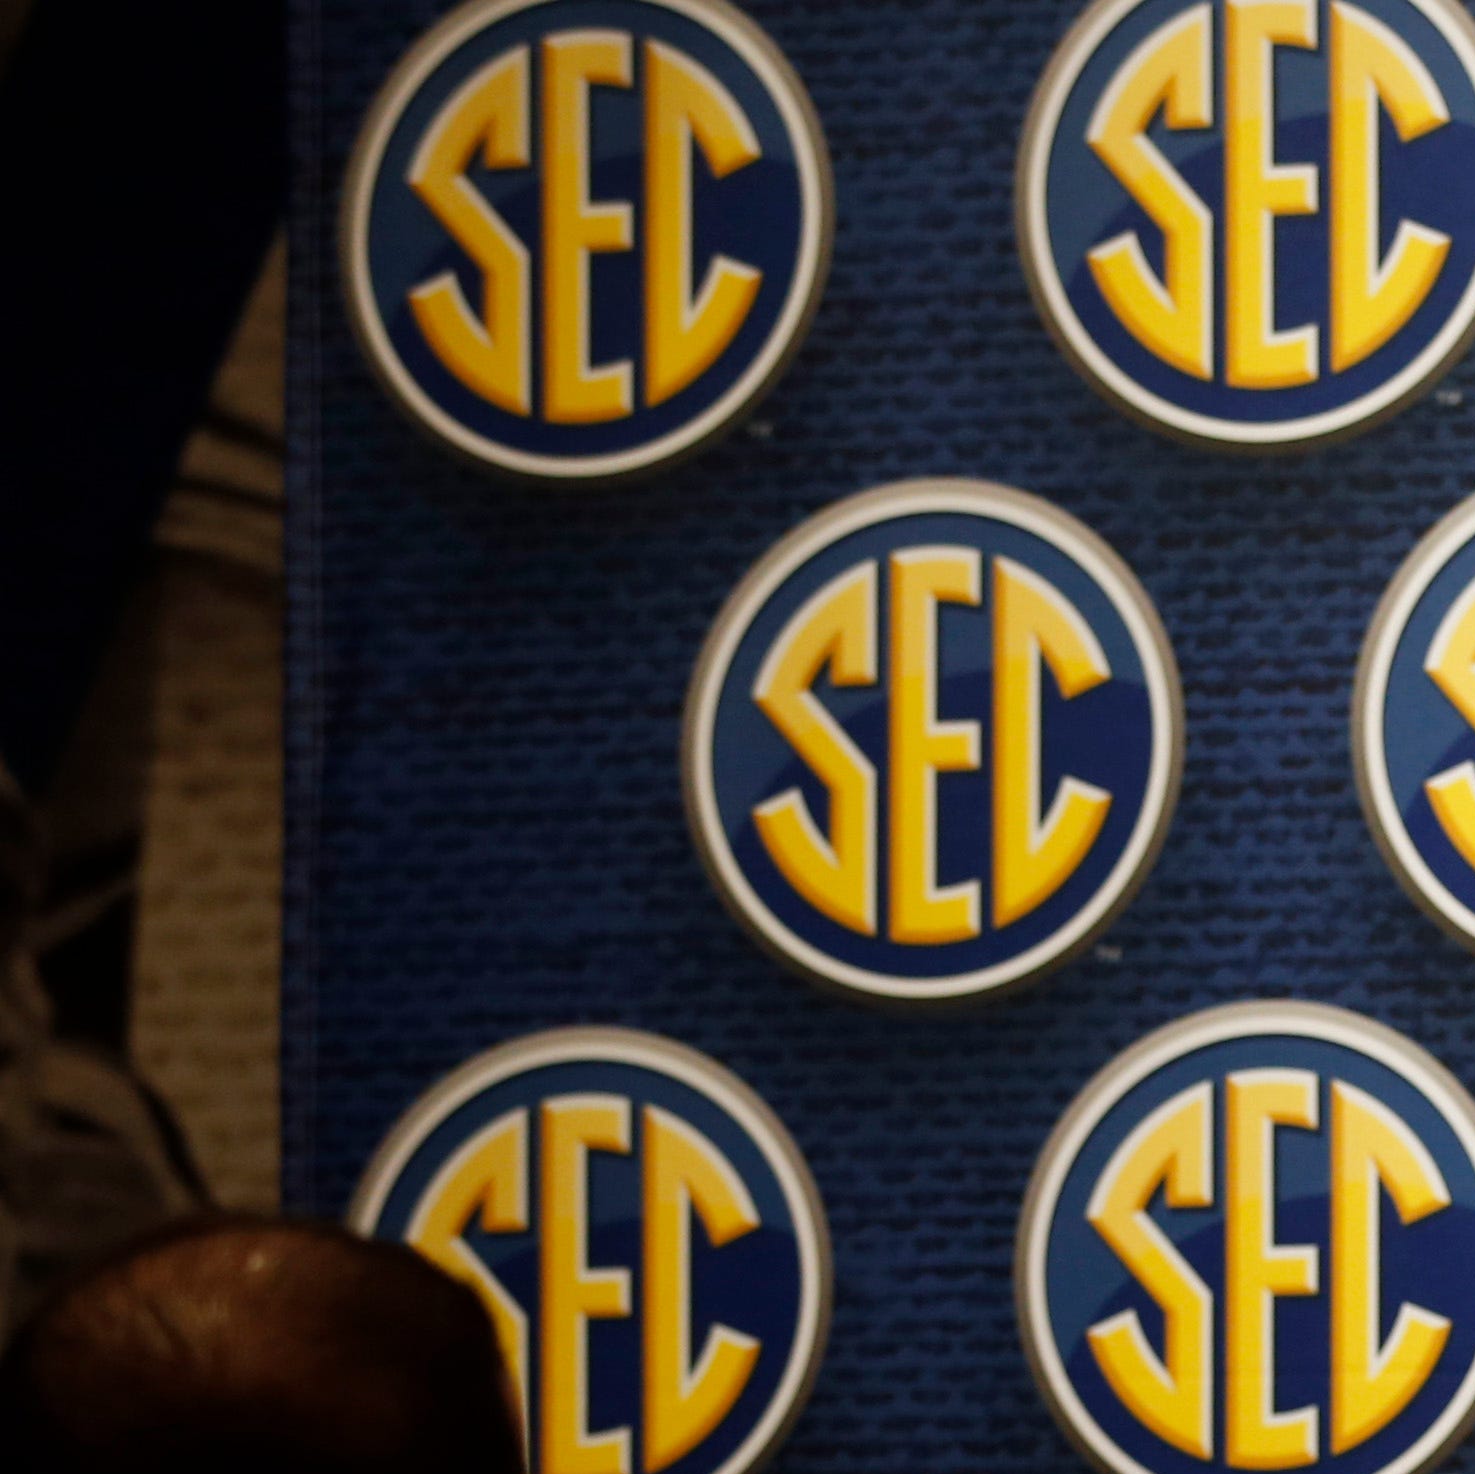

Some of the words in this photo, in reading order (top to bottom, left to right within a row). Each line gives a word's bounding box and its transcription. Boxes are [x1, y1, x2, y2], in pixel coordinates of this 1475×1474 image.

[408, 29, 763, 424] SEC
[1087, 0, 1452, 390] SEC
[752, 545, 1112, 944] SEC
[1087, 1067, 1453, 1470] SEC
